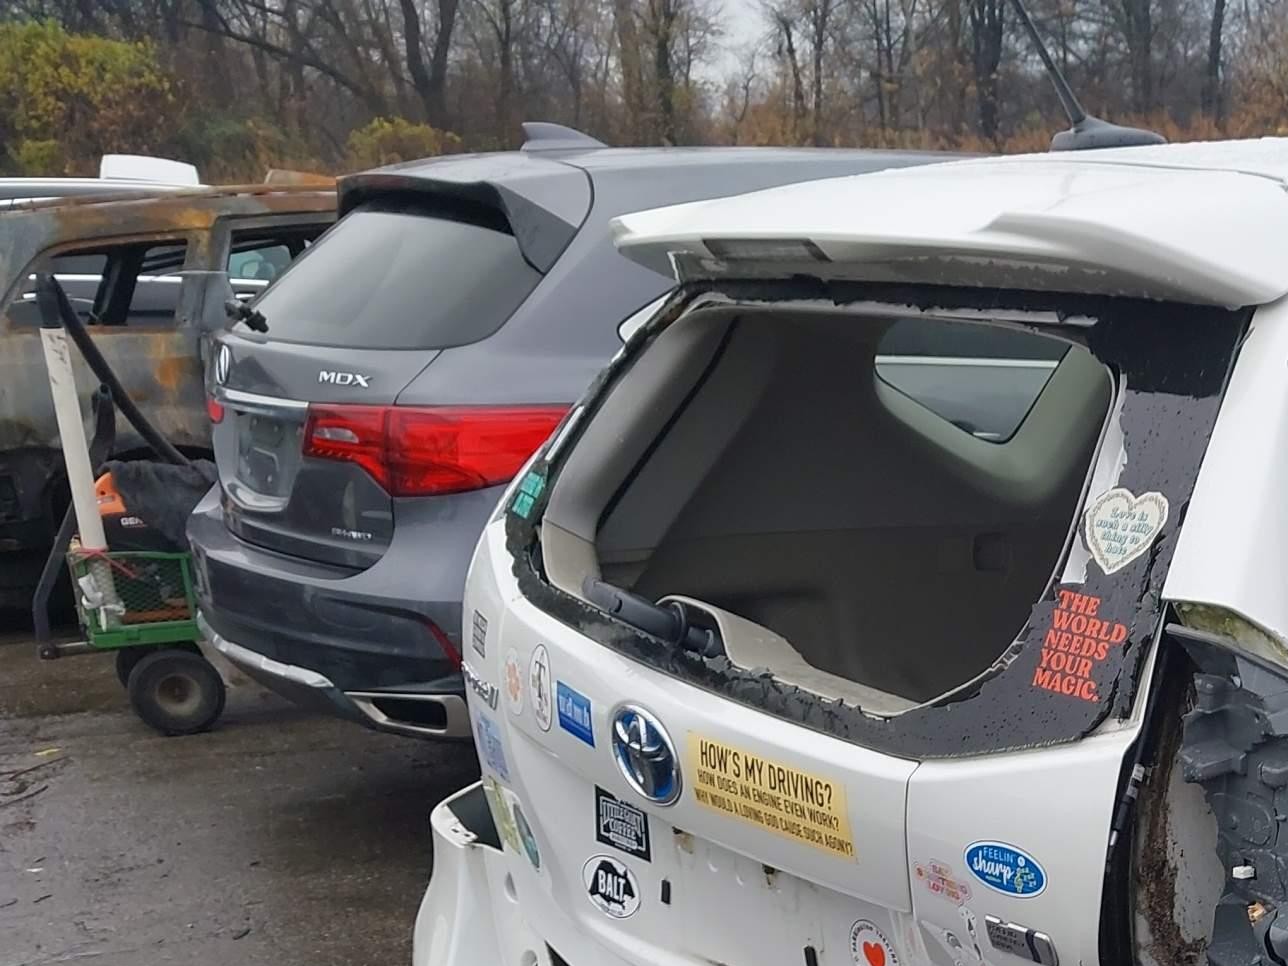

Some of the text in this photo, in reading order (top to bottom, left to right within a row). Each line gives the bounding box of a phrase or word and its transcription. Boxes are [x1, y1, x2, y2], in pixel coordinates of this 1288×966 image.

[318, 370, 372, 388] MDX
[1058, 589, 1101, 616] THE
[1052, 608, 1128, 644] WORLD
[1044, 628, 1110, 661] NEEDS
[1039, 647, 1094, 679] YOUR
[1032, 666, 1100, 702] MAGIC.
[700, 739, 833, 811] HOW'S MY DRIVING?
[697, 768, 841, 833] HOW DOES AN ENGINE EVEN WORK?
[609, 820, 637, 841] COFFEE
[709, 791, 734, 813] WOULD
[734, 800, 740, 815] A
[779, 817, 803, 839] CAUSE
[803, 824, 824, 845] SUCH
[972, 850, 1015, 886] sharp
[598, 869, 626, 902] BALT
